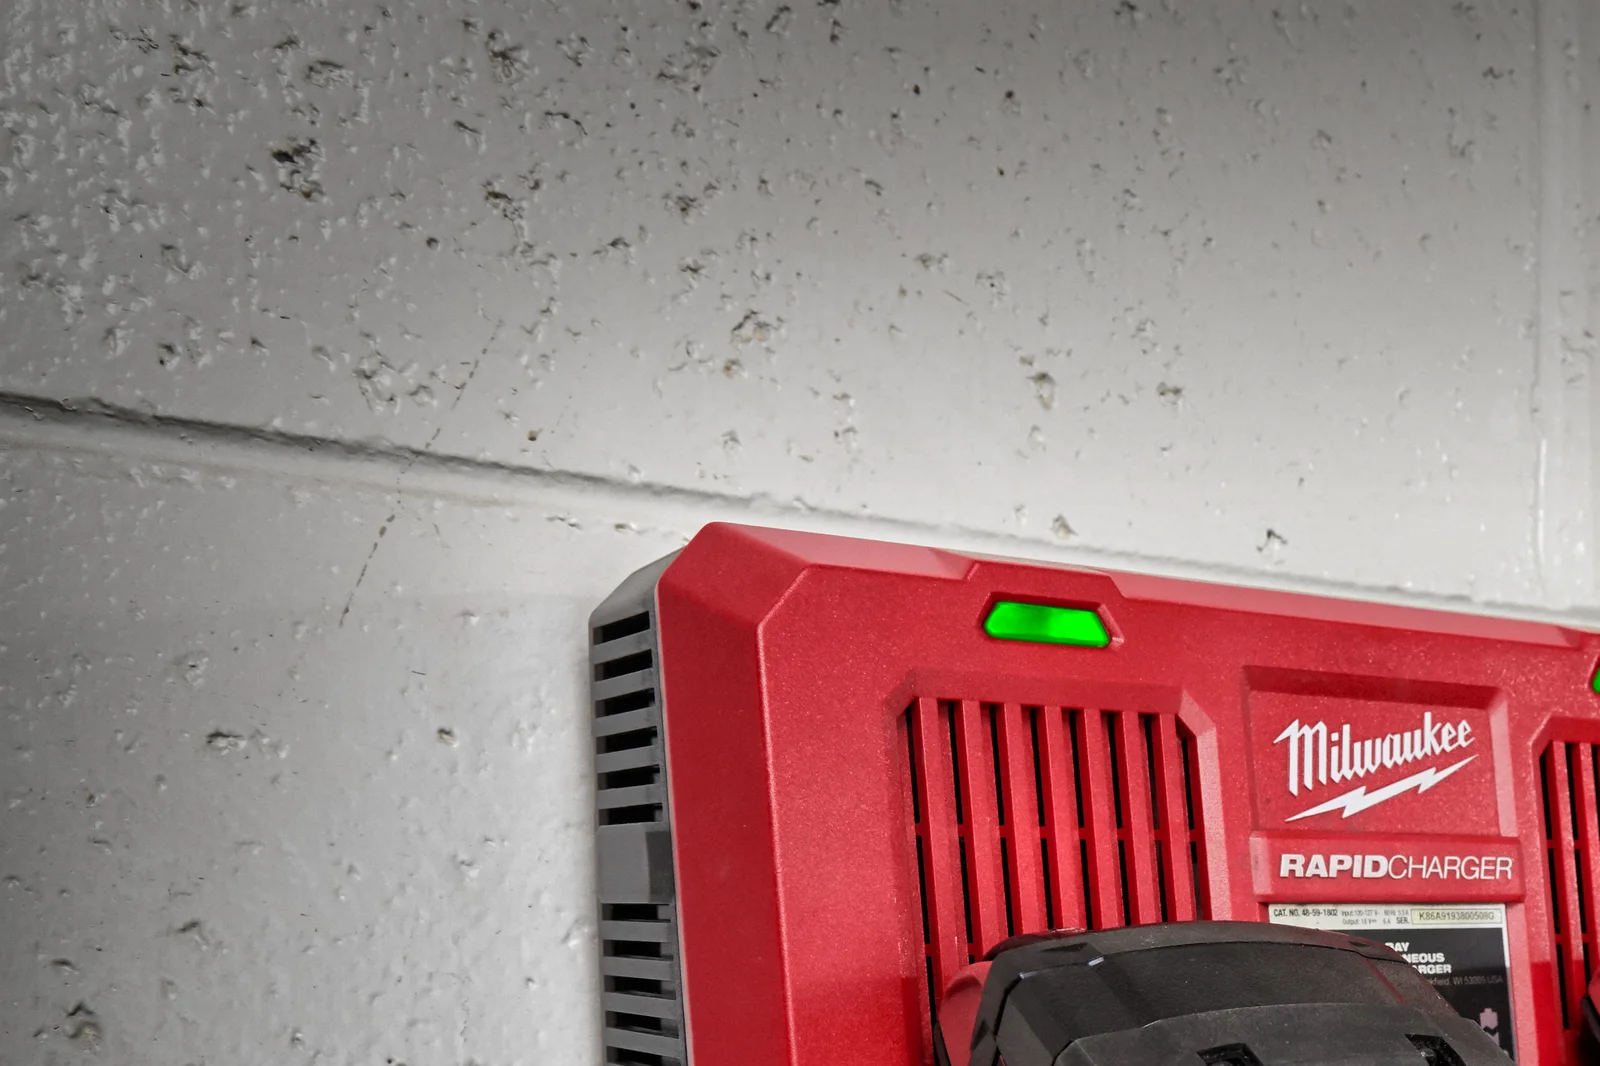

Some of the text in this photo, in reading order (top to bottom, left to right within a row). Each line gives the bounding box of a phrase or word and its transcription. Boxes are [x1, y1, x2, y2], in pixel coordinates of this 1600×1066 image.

[1273, 711, 1475, 796] Milwaukee
[1279, 853, 1513, 880] RAPIDCHARGER
[1400, 952, 1445, 963] NEOUS
[1412, 964, 1452, 974] RGER
